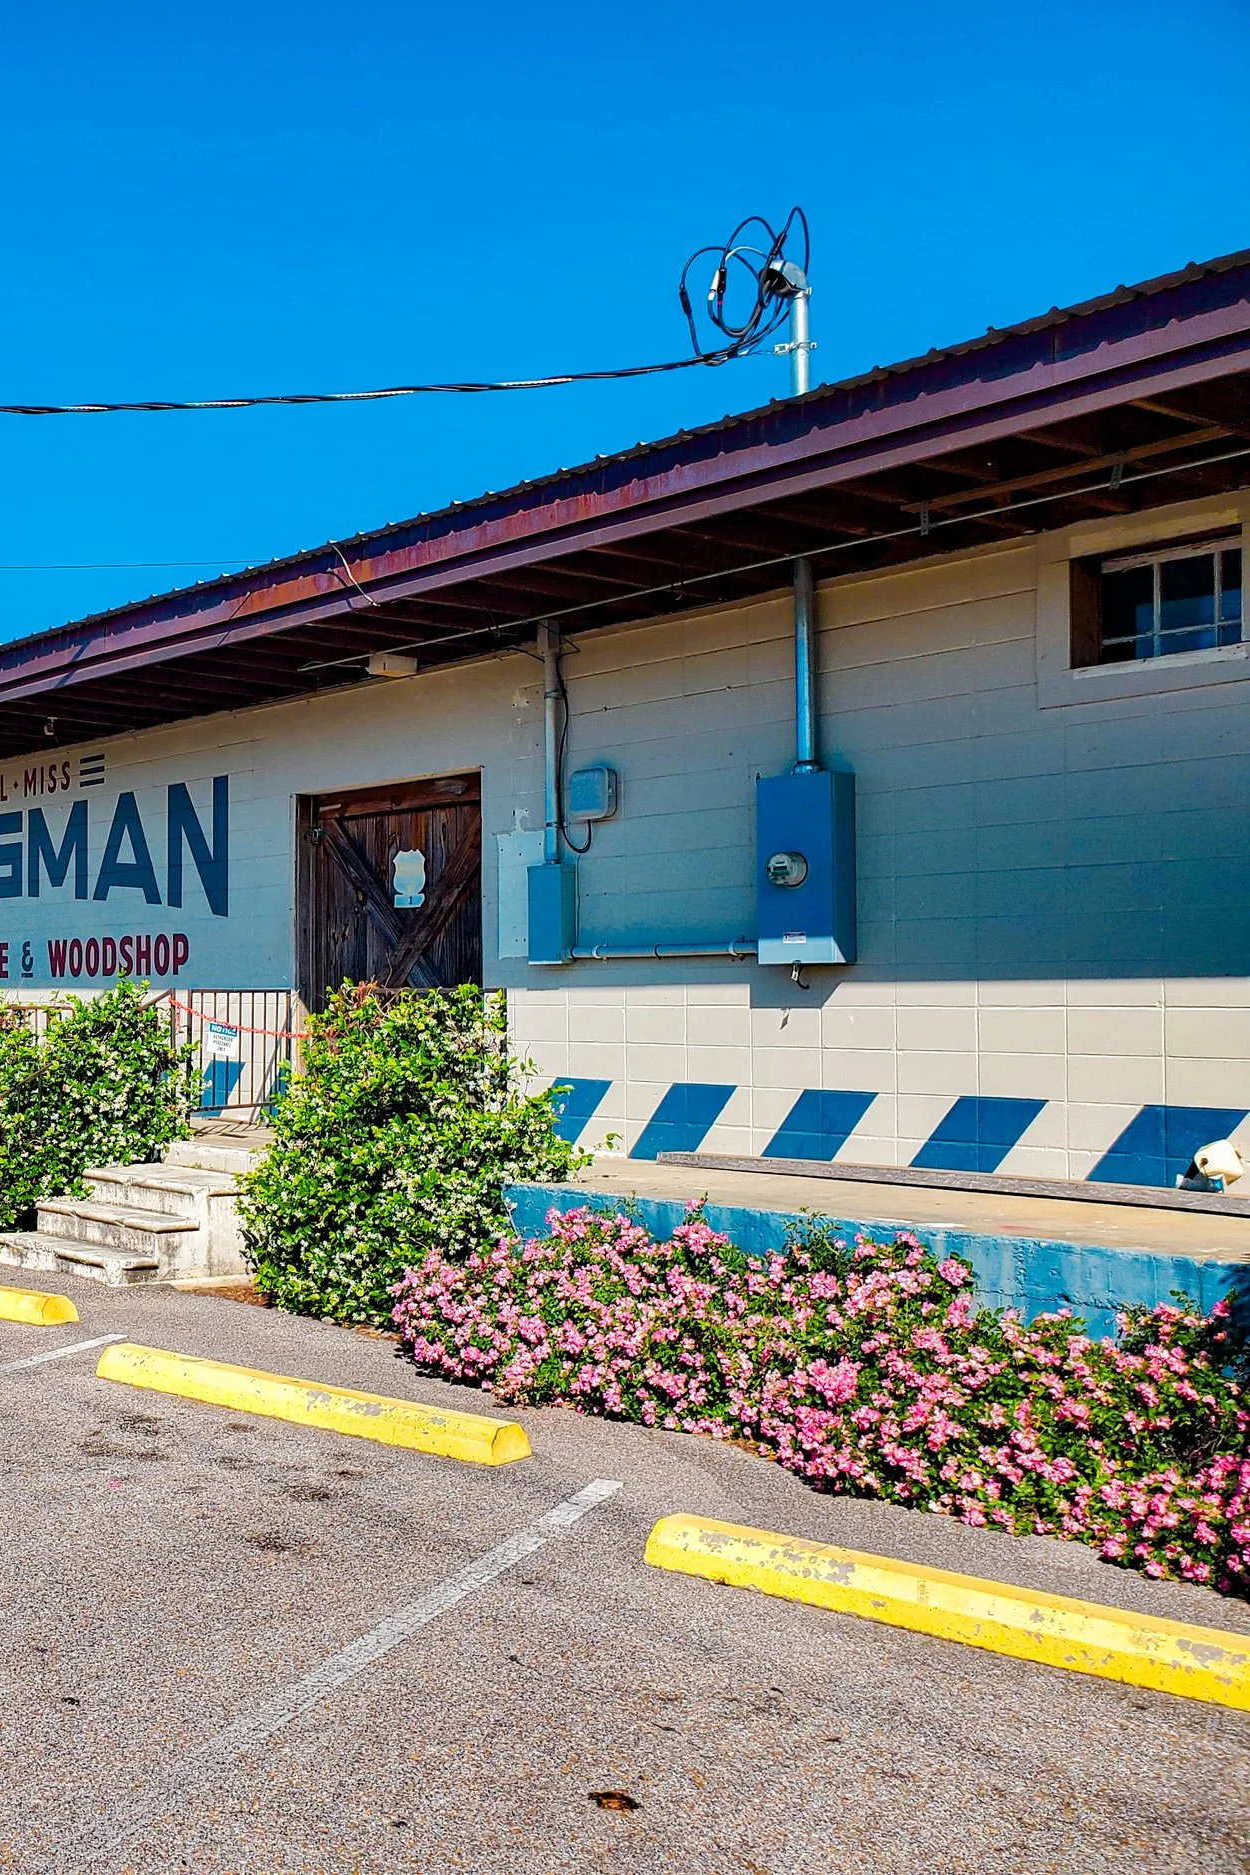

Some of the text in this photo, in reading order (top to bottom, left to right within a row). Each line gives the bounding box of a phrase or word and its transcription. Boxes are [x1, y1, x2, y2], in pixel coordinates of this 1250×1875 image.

[23, 760, 70, 798] MISS
[21, 940, 34, 978] &
[47, 933, 190, 978] WOODSHOP
